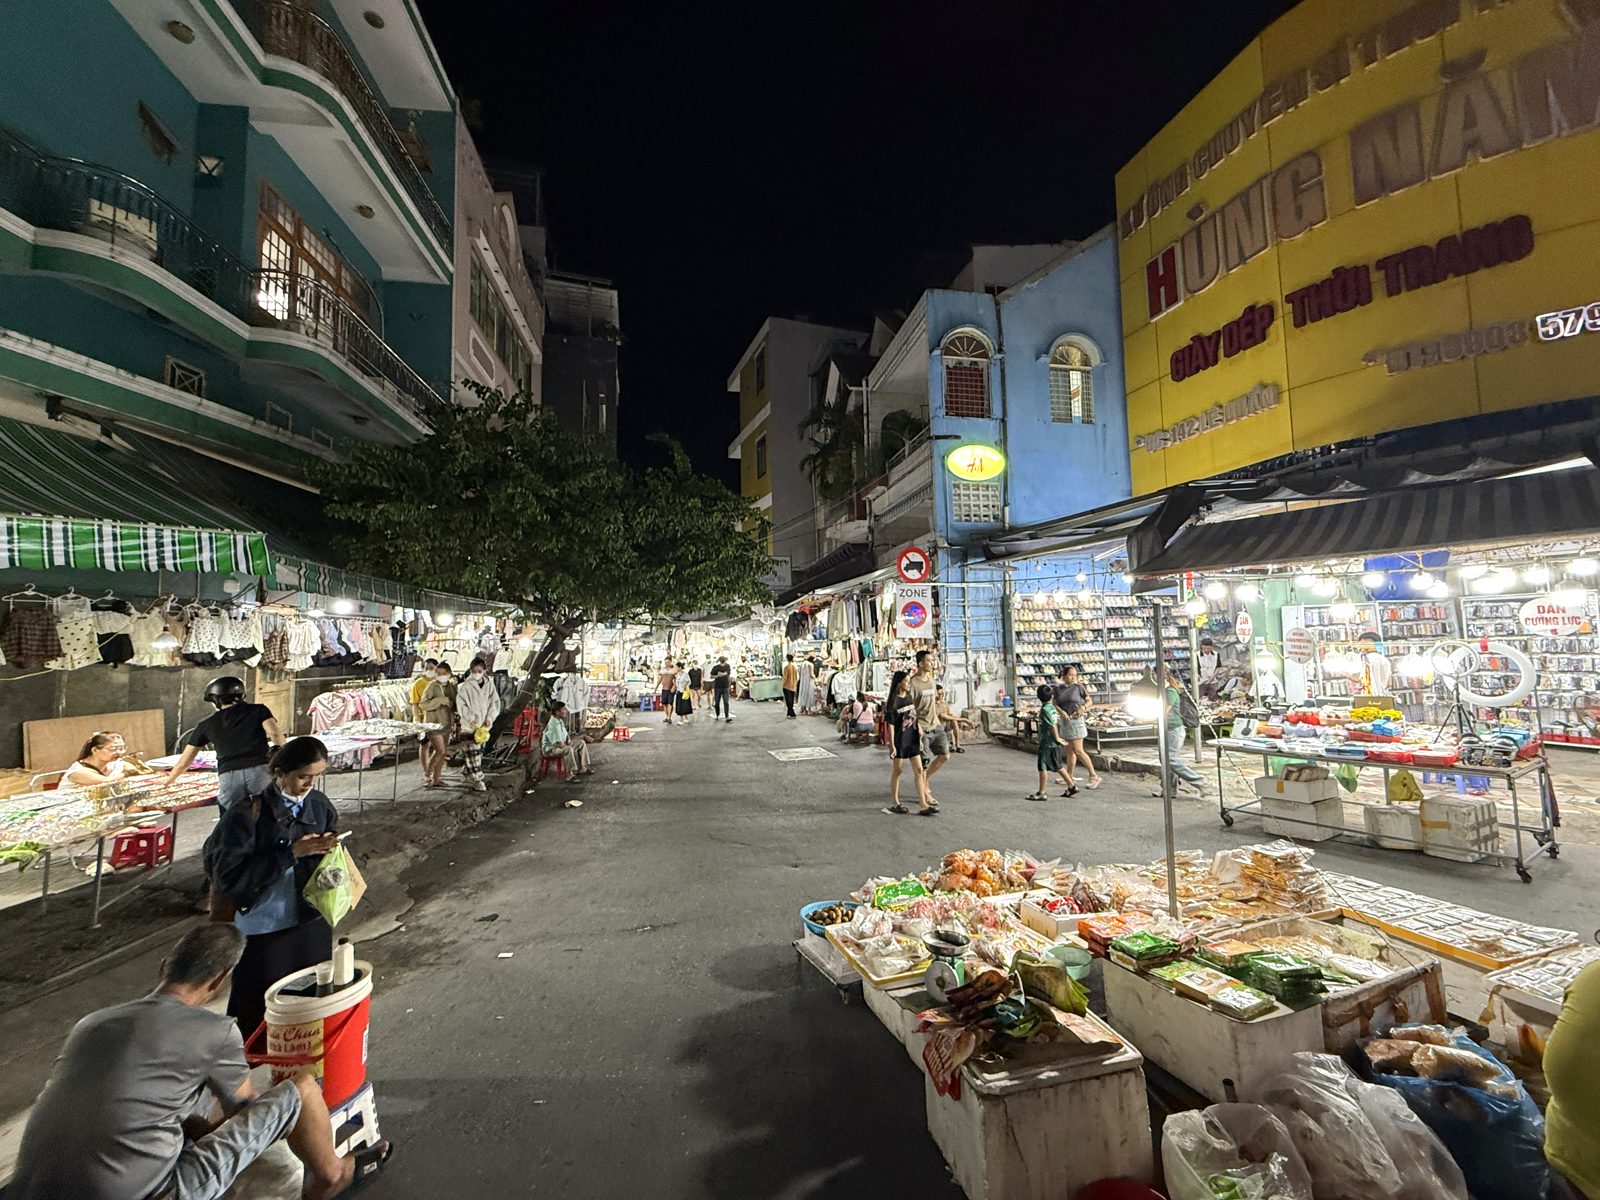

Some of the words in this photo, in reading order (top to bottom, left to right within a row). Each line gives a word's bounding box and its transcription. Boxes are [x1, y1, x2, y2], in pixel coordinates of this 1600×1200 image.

[1170, 329, 1221, 383] GIÀY
[1222, 304, 1274, 359] DÉP
[1285, 266, 1373, 329] THỜI
[1375, 214, 1534, 298] TRANG
[899, 588, 927, 598] ZONE
